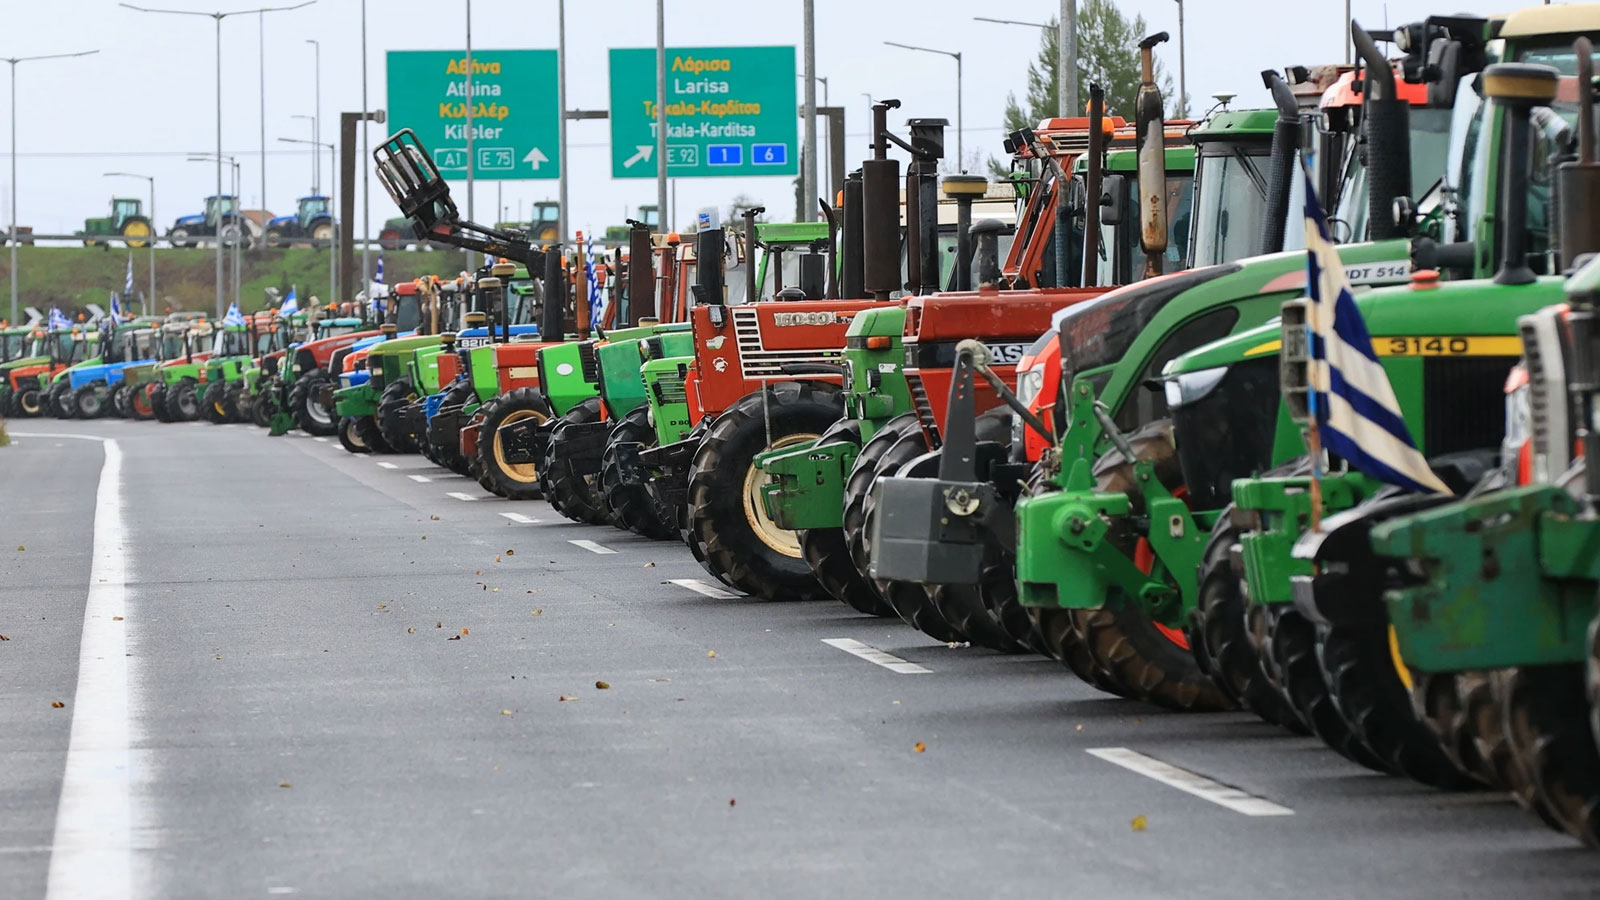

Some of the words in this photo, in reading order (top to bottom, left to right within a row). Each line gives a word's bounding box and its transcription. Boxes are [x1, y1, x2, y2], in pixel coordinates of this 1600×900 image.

[446, 59, 501, 74] Αθήνα
[672, 57, 731, 75] Λάρισα
[446, 81, 501, 96] Athina
[674, 79, 729, 94] Larisa
[643, 100, 761, 119] Τρκαλα-Καρδίτσα
[445, 124, 503, 139] Kileler
[649, 121, 756, 138] Tkala-Karditsa
[445, 152, 461, 165] A1
[482, 152, 490, 166] E
[496, 152, 511, 166] 75
[667, 149, 675, 162] E
[680, 149, 695, 162] 92
[722, 148, 728, 162] 1
[764, 147, 774, 161] 6
[1376, 266, 1405, 278] 514
[991, 345, 1032, 362] AS
[1390, 338, 1468, 354] 3140
